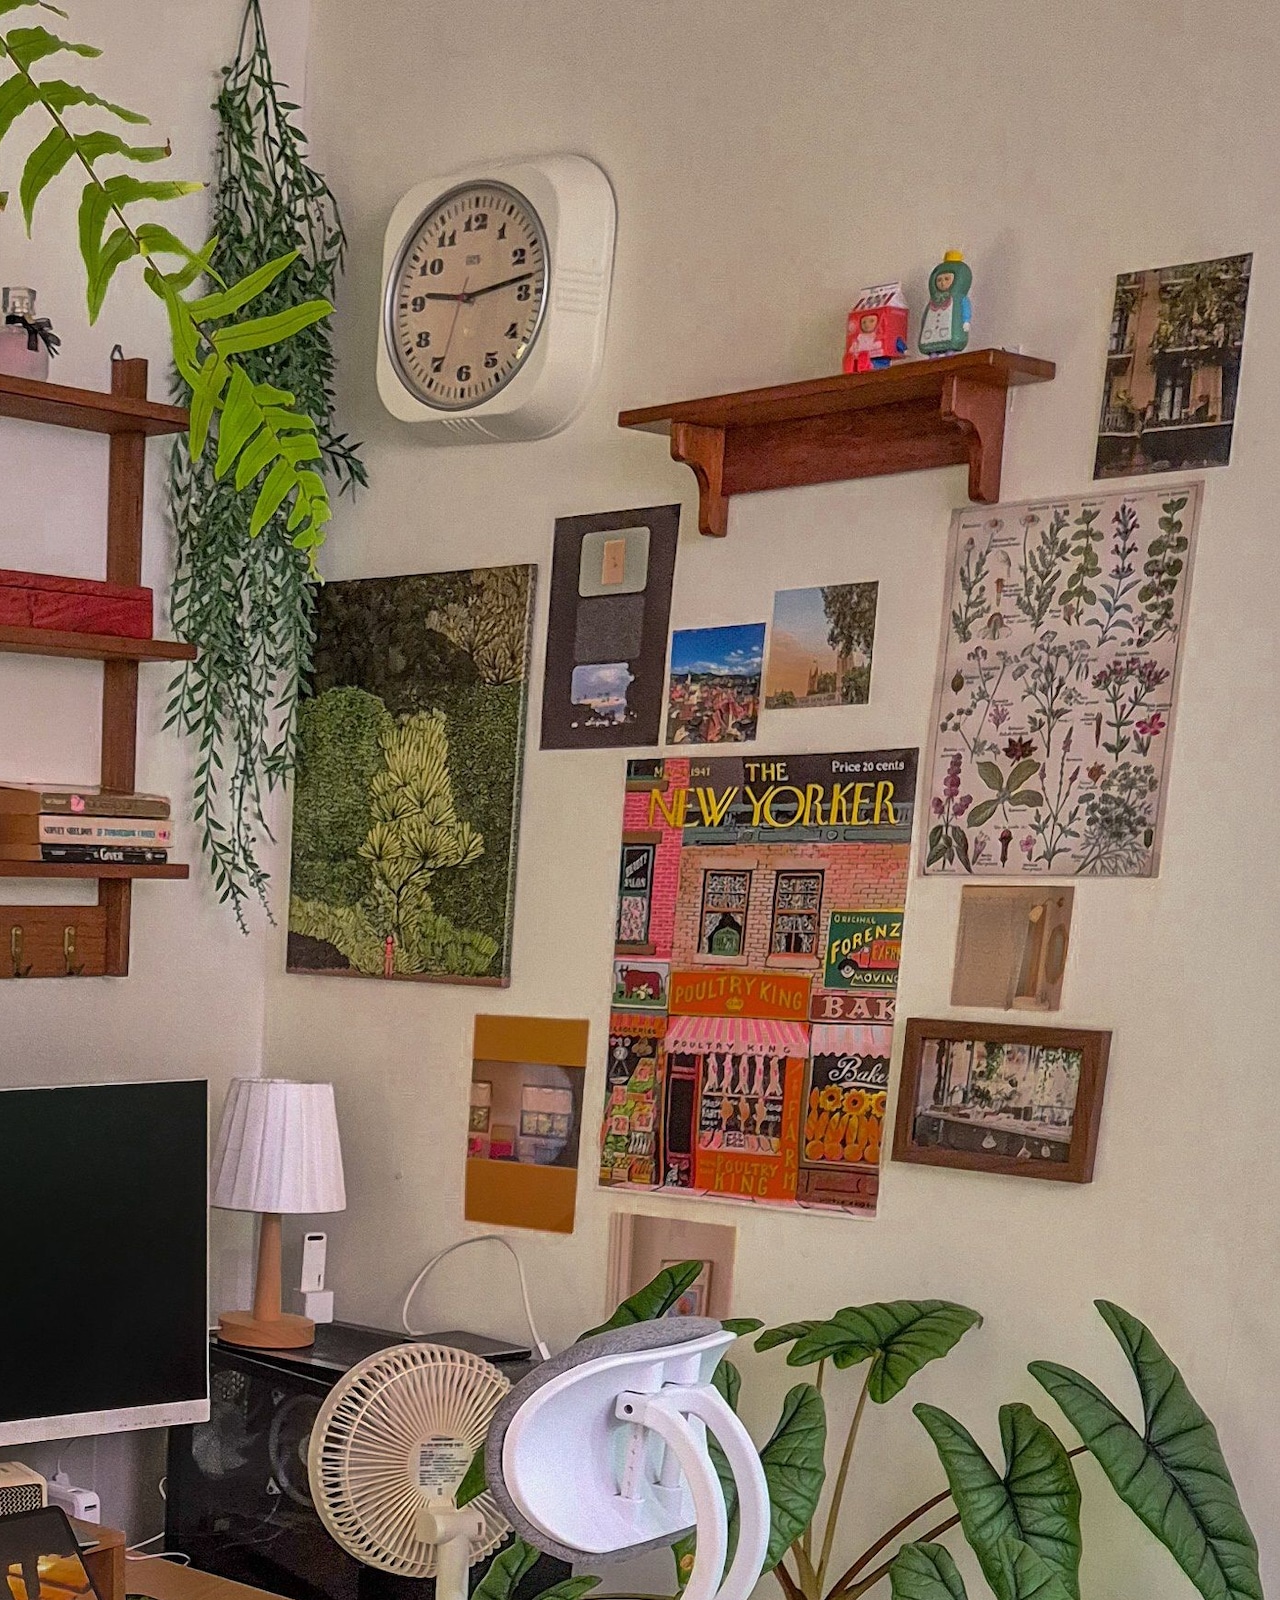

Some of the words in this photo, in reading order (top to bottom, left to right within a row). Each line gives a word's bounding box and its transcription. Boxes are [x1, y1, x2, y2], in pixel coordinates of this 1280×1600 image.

[463, 213, 489, 233] 12
[497, 222, 507, 240] 1
[437, 230, 457, 248] 11
[512, 248, 526, 266] 2
[419, 258, 444, 276] 10
[516, 284, 531, 301] 3
[411, 296, 426, 313] 9
[416, 331, 431, 348] 8
[504, 323, 518, 339] 4
[431, 356, 445, 373] 7
[484, 351, 498, 368] 5
[456, 365, 471, 382] 6
[690, 766, 711, 778] 1941
[745, 761, 789, 783] THE
[831, 759, 862, 773] Price
[862, 761, 875, 772] 20
[875, 760, 905, 772] cents
[648, 786, 739, 828] NEW
[744, 780, 899, 828] YORKER
[675, 975, 757, 1004] POULTRY
[759, 981, 803, 1011] KING
[821, 996, 896, 1020] BAK
[673, 1039, 735, 1051] POULTRY
[746, 1044, 791, 1055] KING
[715, 1154, 779, 1178] POULTRY
[714, 1171, 769, 1196] KING
